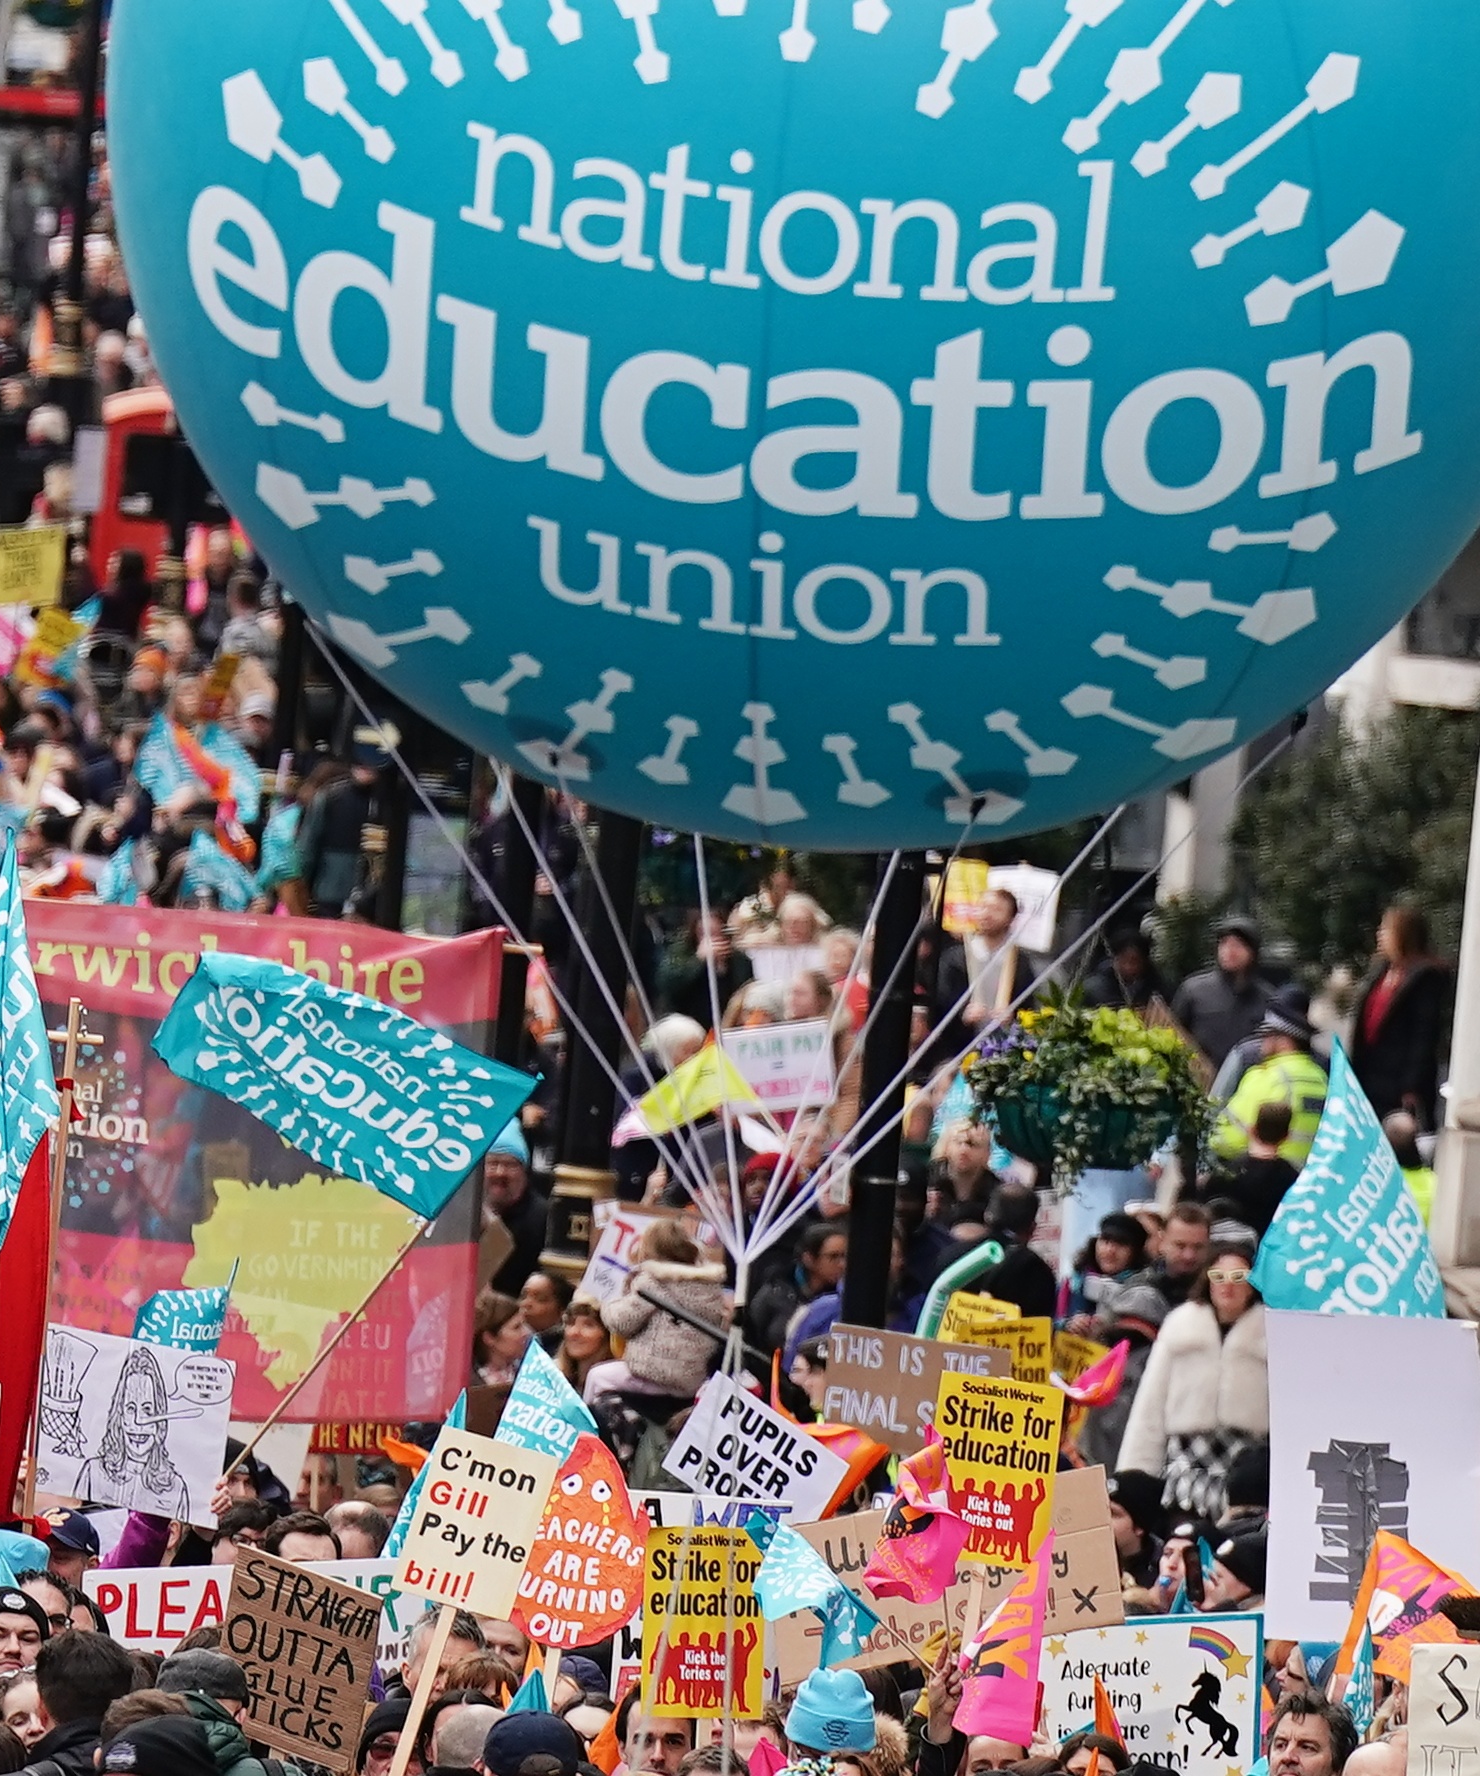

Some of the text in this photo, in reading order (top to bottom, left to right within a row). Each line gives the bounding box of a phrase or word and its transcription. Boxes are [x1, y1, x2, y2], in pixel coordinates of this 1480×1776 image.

[459, 119, 1116, 305] national
[187, 184, 1423, 522] education
[527, 515, 1001, 648] union
[289, 1220, 383, 1249] IF THE
[247, 1253, 404, 1283] GOVERNMENT
[831, 1332, 883, 1369] THIS
[899, 1343, 926, 1376] IS
[944, 1352, 992, 1376] THE
[1020, 1335, 1046, 1359] for
[823, 1385, 909, 1434] FINAL
[961, 1380, 1046, 1405] Socialist Worker
[720, 1394, 818, 1477] PUPILS
[943, 1395, 1056, 1441] Strike for
[439, 1446, 537, 1494] C'mon
[678, 1445, 767, 1499] PROF
[717, 1434, 790, 1499] OVER
[943, 1434, 1051, 1474] education
[429, 1480, 489, 1518] Gill
[961, 1509, 1015, 1532] Tories out
[967, 1495, 1012, 1516] Kick the
[418, 1511, 526, 1564] Pay the
[534, 1515, 645, 1567] EACHERS
[667, 1532, 748, 1548] Soalist Woker
[403, 1559, 475, 1604] bill!
[543, 1550, 601, 1586] ARE
[651, 1549, 721, 1582] Strike
[96, 1579, 226, 1640] PLEA
[237, 1559, 380, 1641] STRAIGHT
[517, 1571, 626, 1614] URNING
[226, 1613, 355, 1684] OUTTA
[529, 1612, 584, 1644] OUT
[679, 1664, 728, 1682] Tories ou
[685, 1650, 727, 1666] Kick the
[1061, 1656, 1150, 1683] Adequate
[241, 1660, 337, 1715] GLUE
[248, 1693, 344, 1750] TICKS
[1120, 1723, 1151, 1741] are
